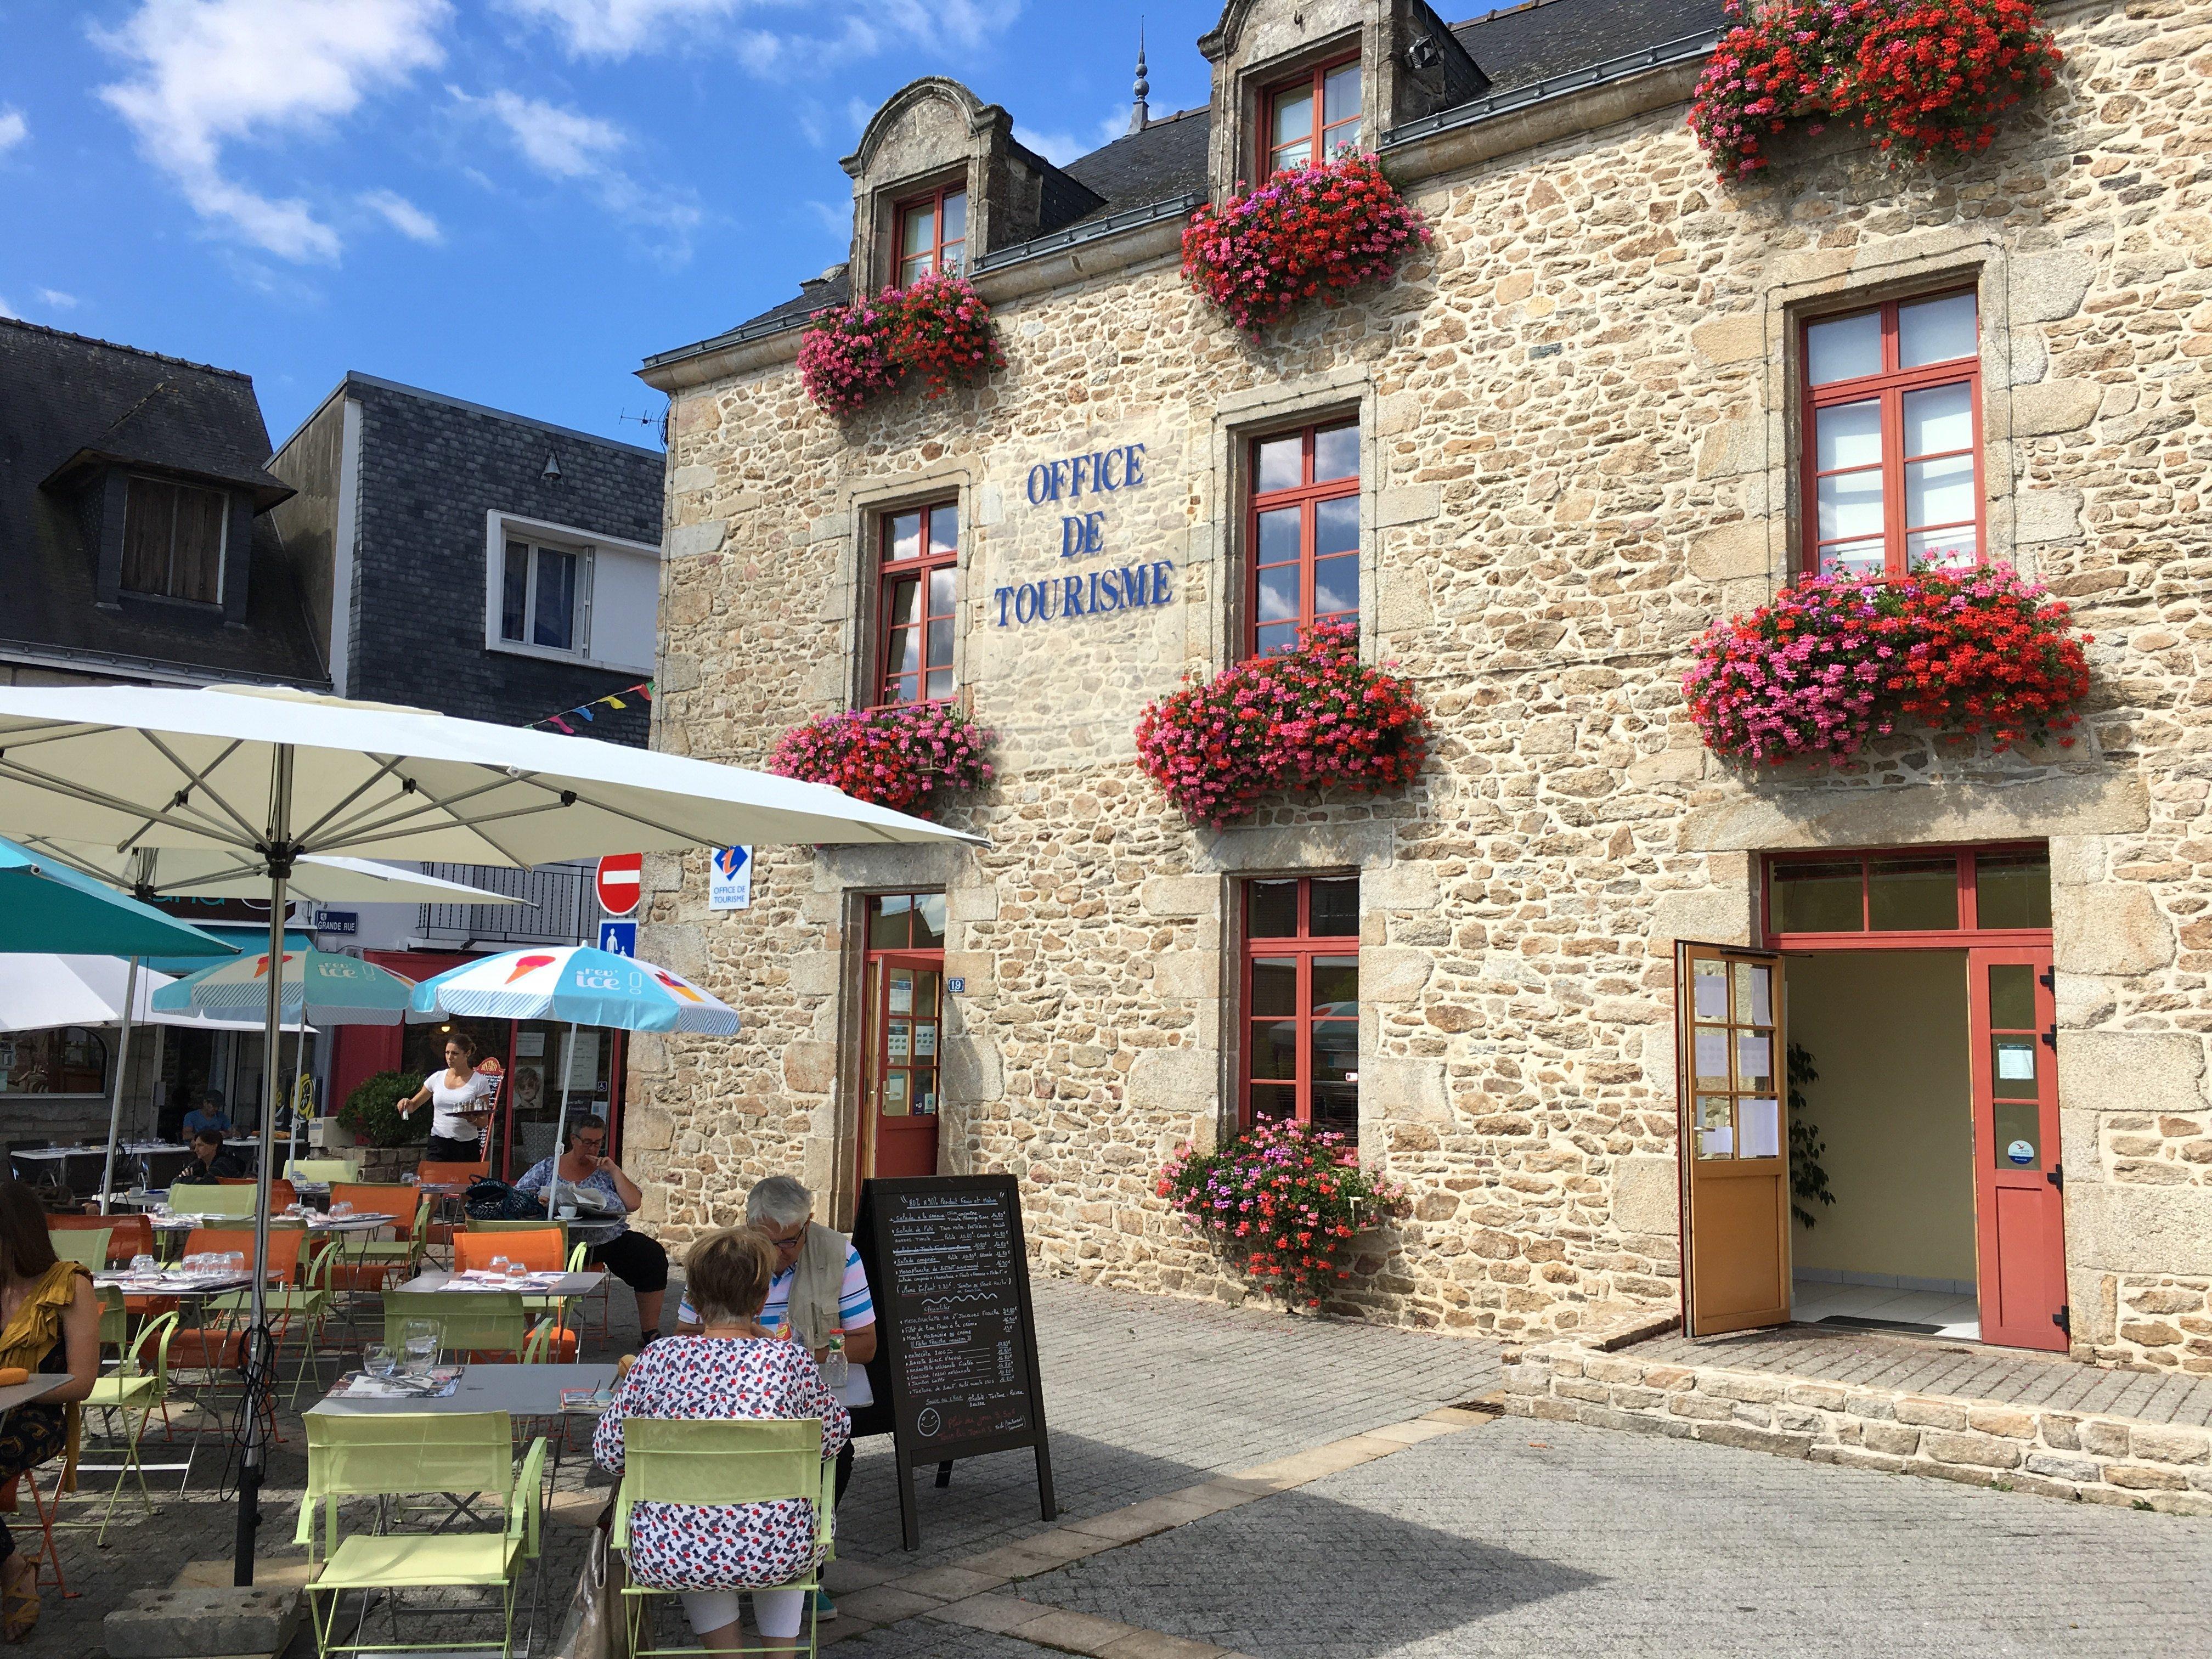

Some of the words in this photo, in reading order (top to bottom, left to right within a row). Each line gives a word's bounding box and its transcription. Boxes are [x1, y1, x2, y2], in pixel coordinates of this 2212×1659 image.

[1027, 443, 1145, 505] OFFICE
[1059, 511, 1105, 557] DE
[994, 560, 1173, 627] TOURISME
[714, 886, 735, 894] OFFICE
[318, 922, 342, 930] GRANDE
[343, 923, 355, 931] RUE
[318, 964, 358, 978] ice
[576, 970, 621, 990] ice
[951, 980, 961, 990] 19
